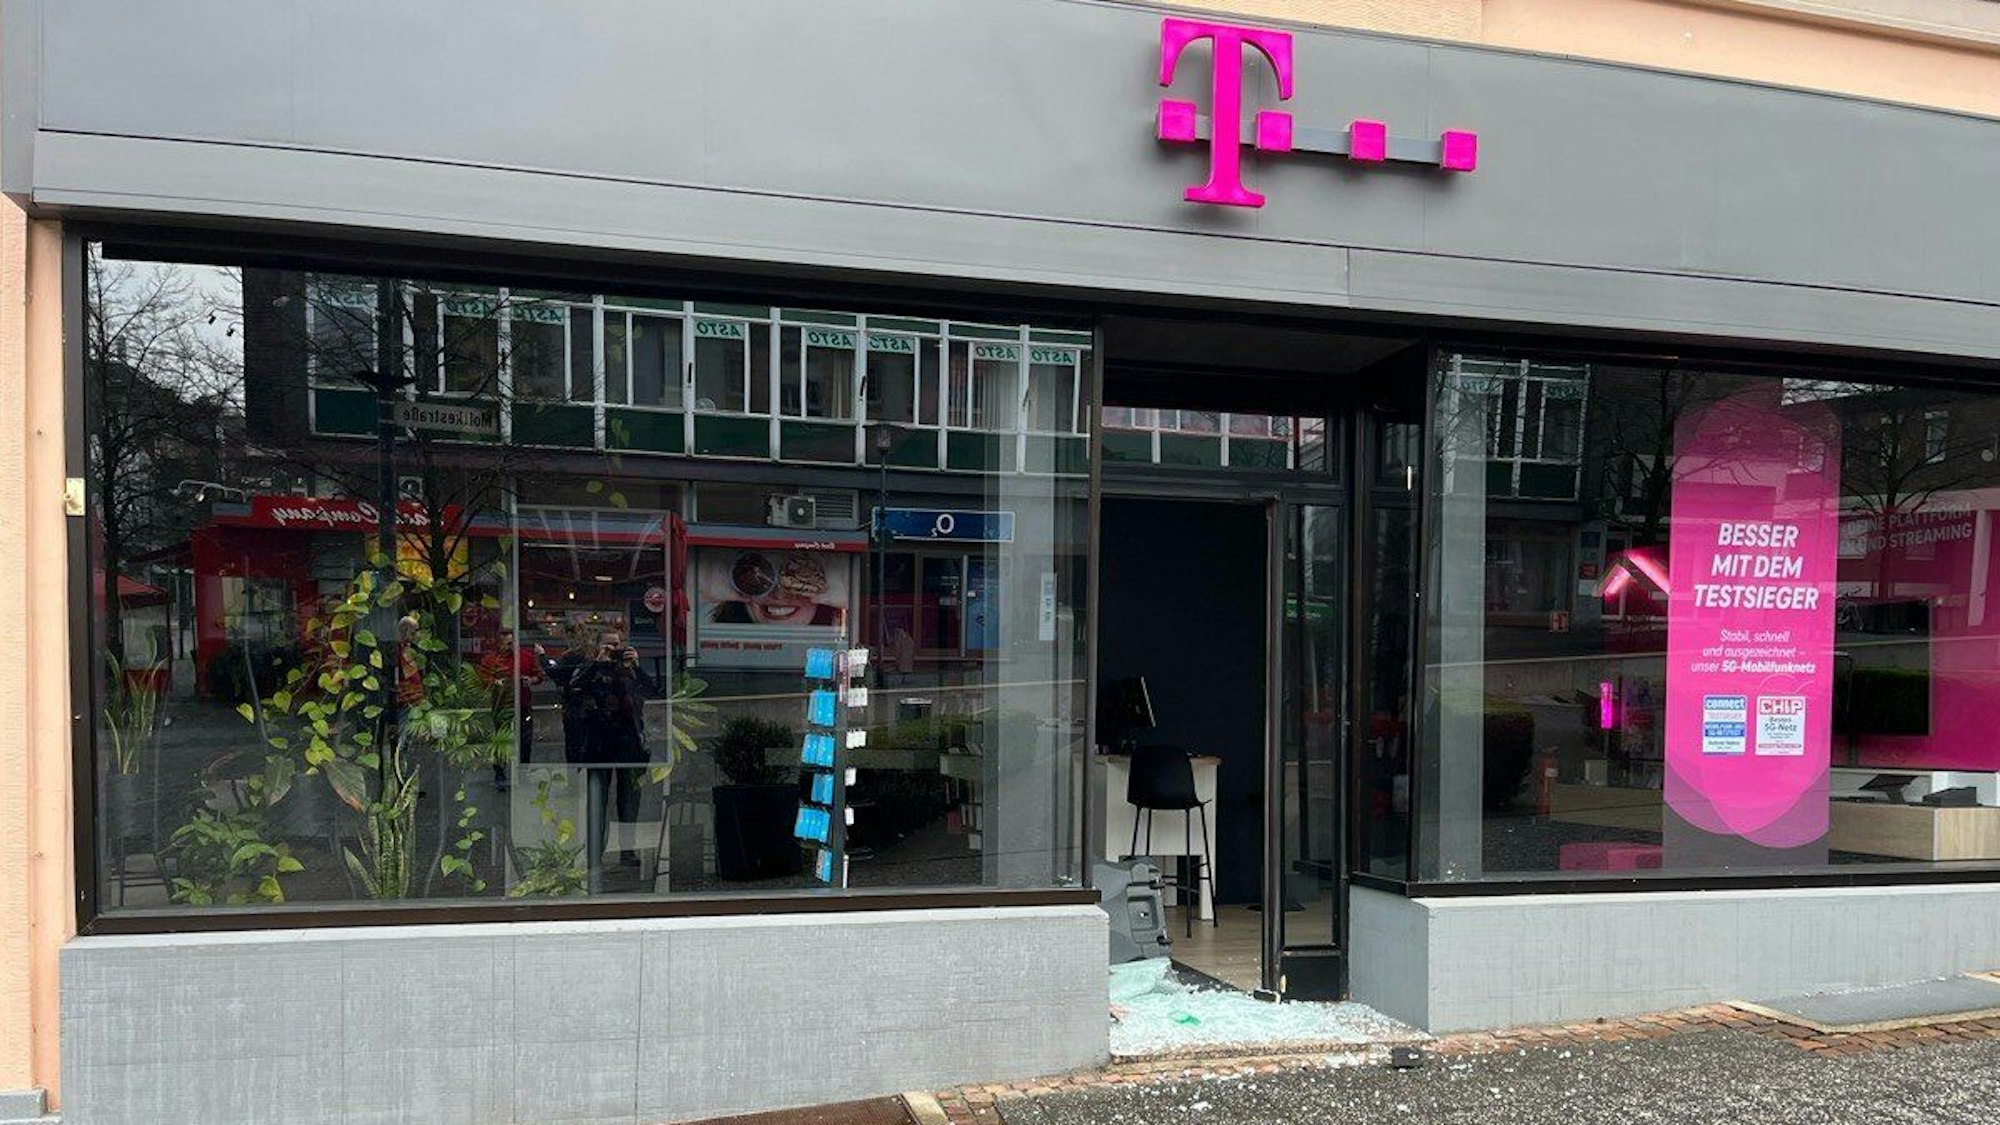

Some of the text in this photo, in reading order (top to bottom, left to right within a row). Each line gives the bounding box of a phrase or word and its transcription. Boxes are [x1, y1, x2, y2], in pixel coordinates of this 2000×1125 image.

[1159, 18, 1293, 207] T
[1889, 503, 1971, 528] PLATTFORM
[1718, 522, 1799, 548] BESSER
[1889, 522, 1972, 548] STREAMING
[1711, 553, 1804, 579] MIT DEM
[1694, 584, 1819, 610] TESTSIEGER
[1721, 629, 1791, 643] Stabil, schnell
[1703, 645, 1724, 657] und
[1724, 646, 1797, 658] ausgezeichnet
[1691, 659, 1816, 674] unser 5G-Mobilfunknetz
[1706, 697, 1745, 710] connect
[1760, 699, 1803, 715] CHIP
[1765, 723, 1798, 732] 5G-Netz
